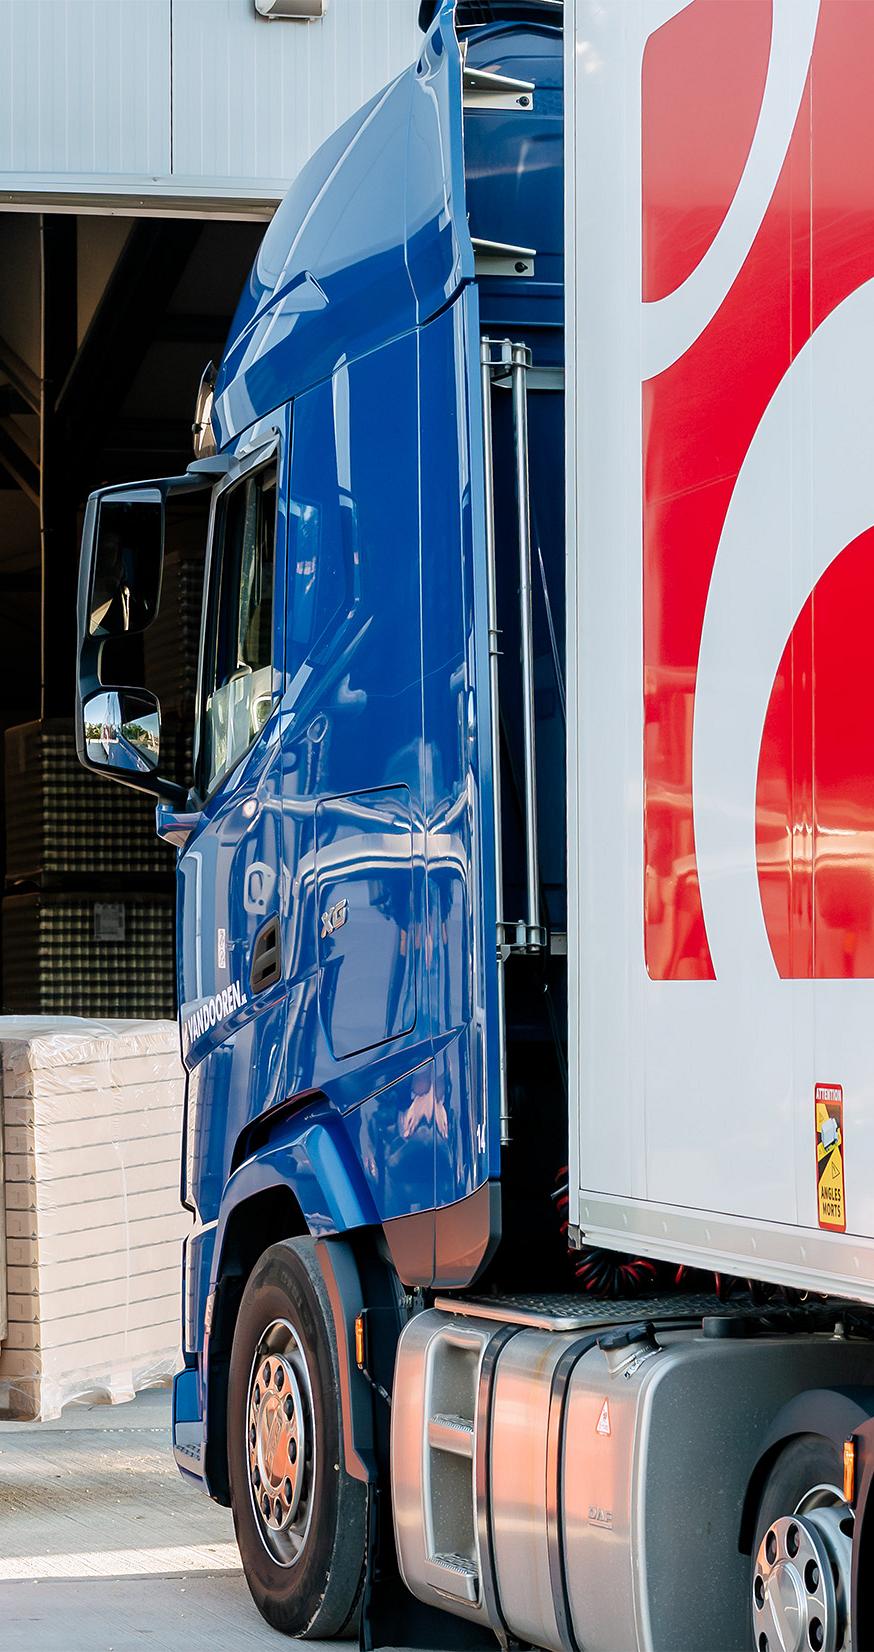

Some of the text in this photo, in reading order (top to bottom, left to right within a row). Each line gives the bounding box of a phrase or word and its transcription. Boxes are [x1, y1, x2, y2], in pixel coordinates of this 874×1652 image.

[321, 899, 348, 939] XG
[815, 1088, 842, 1102] ATTENTION
[821, 1186, 841, 1201] ANGLES
[822, 1202, 841, 1218] MORTS
